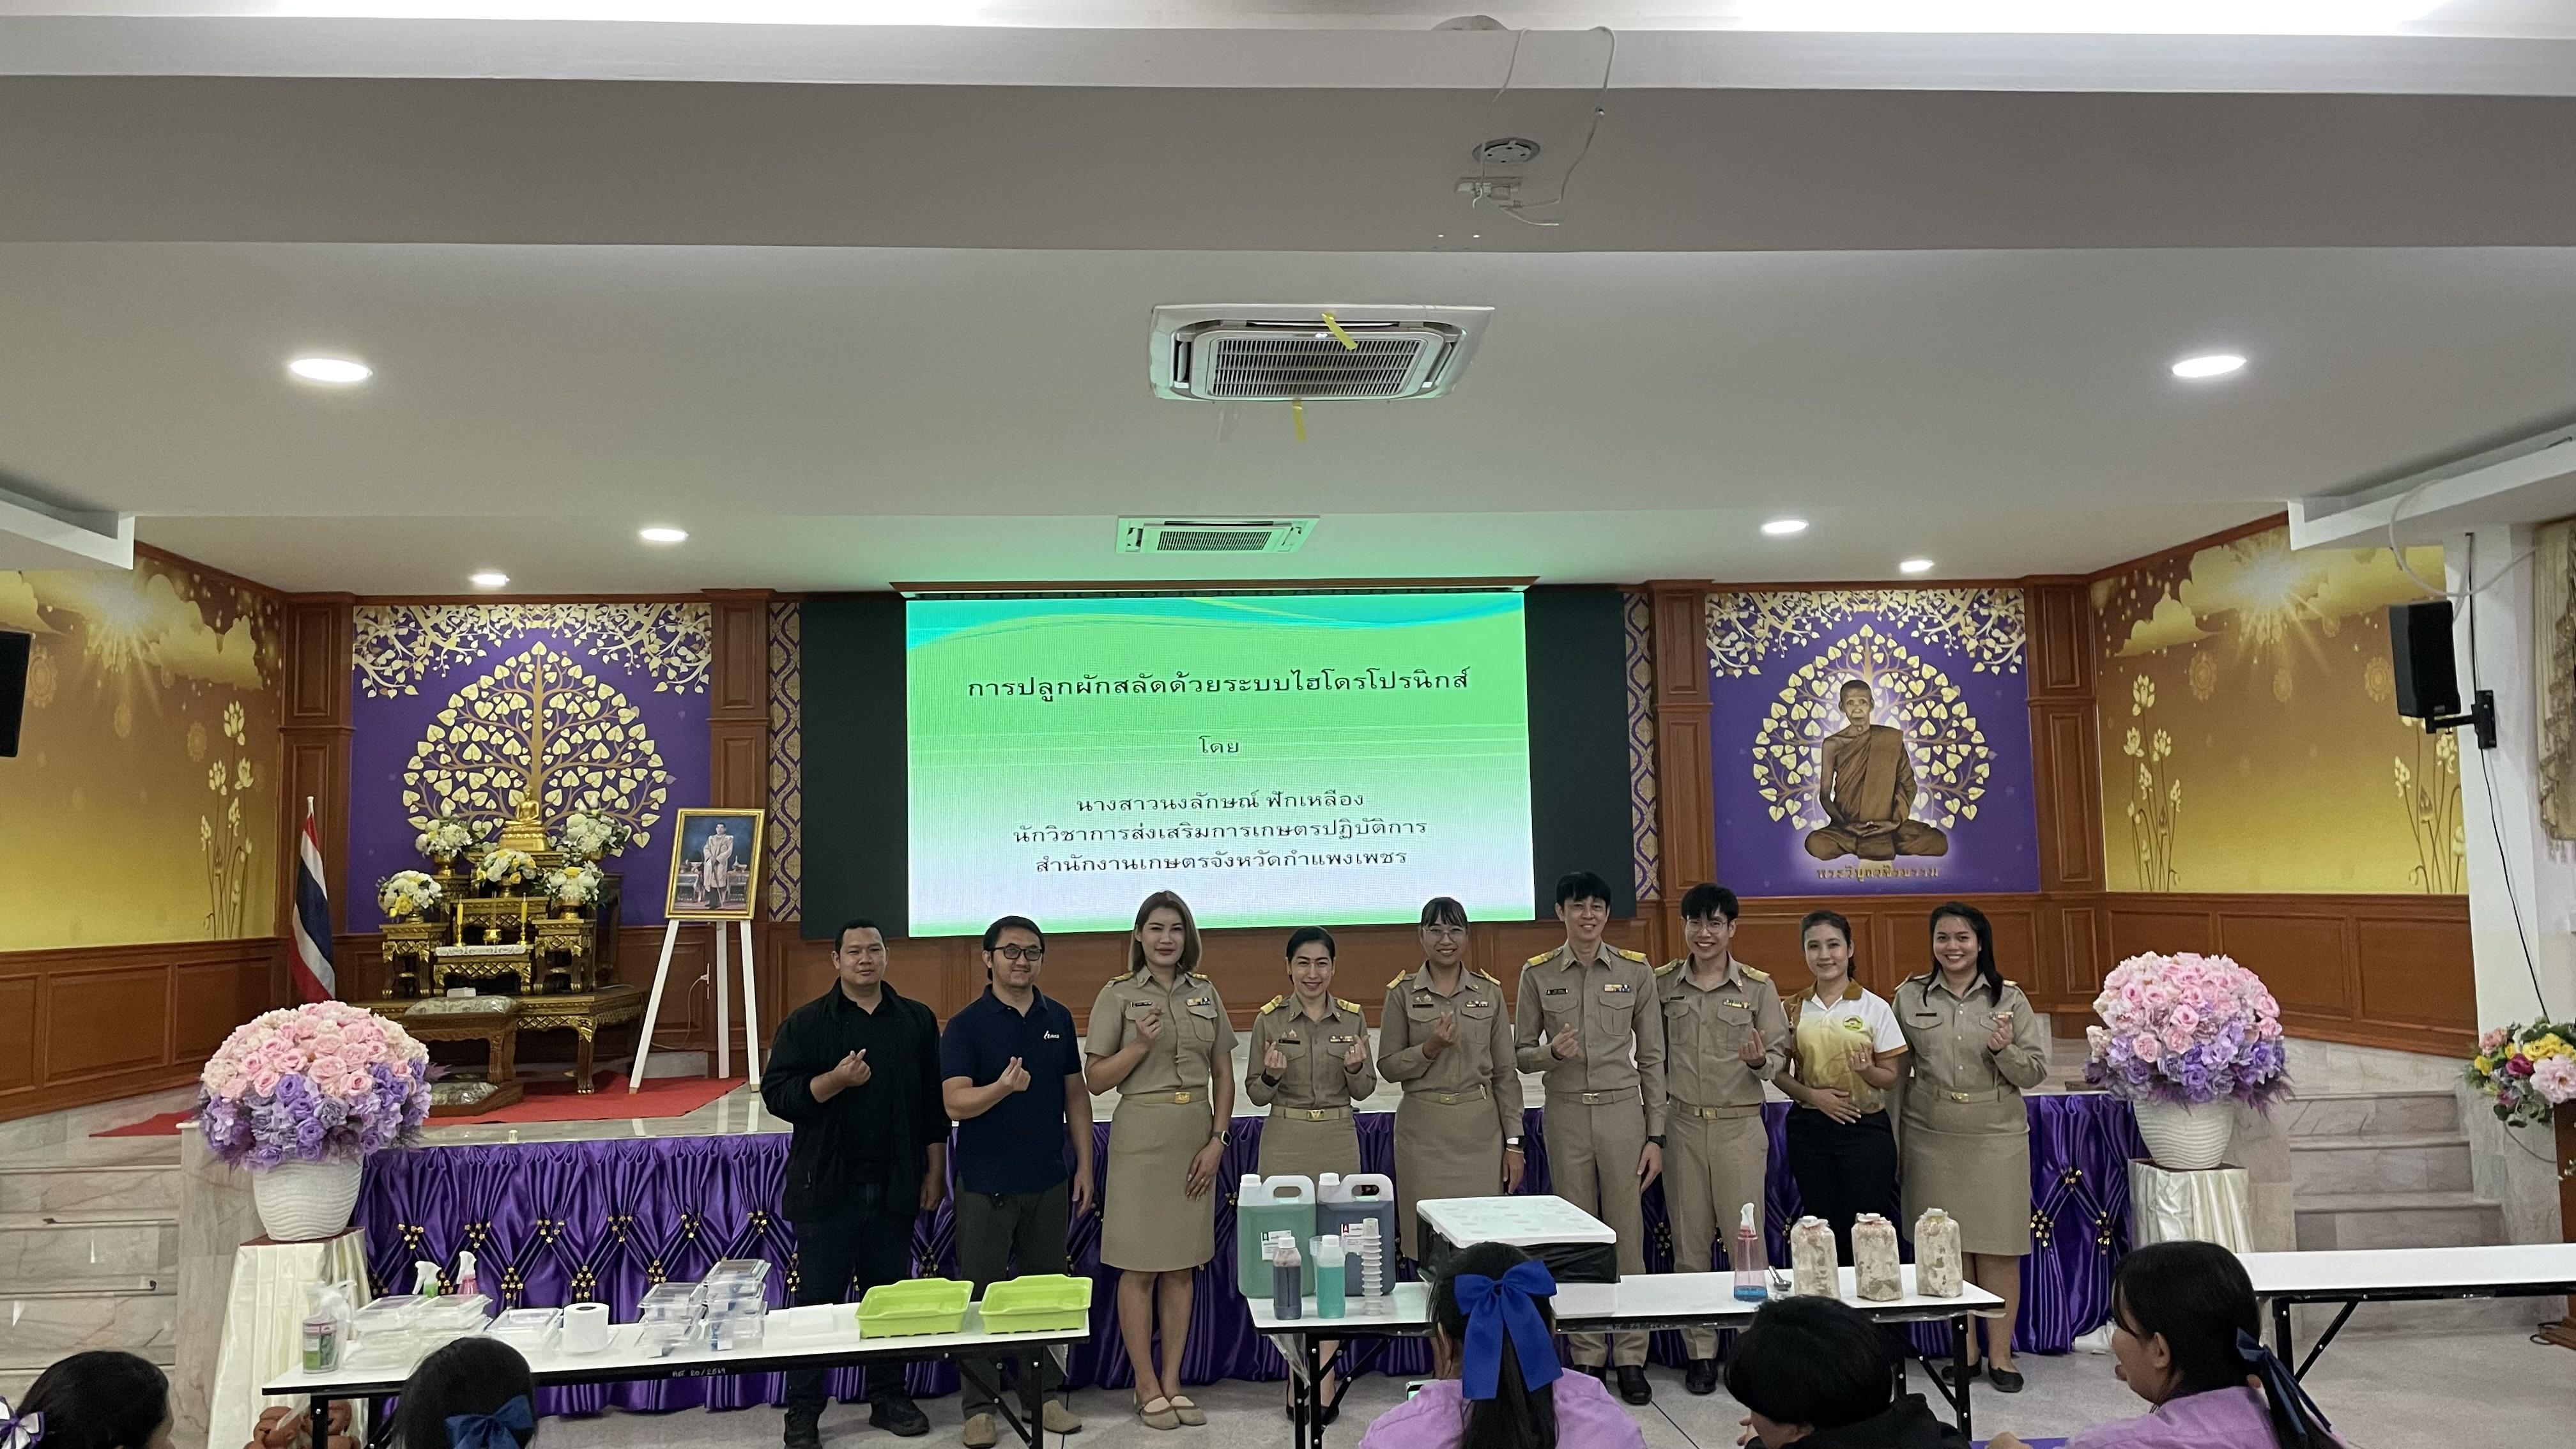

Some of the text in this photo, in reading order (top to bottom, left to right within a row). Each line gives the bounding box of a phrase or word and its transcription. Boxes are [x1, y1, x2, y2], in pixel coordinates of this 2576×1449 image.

[968, 666, 1470, 702] การปลูกผักสลัดด้วยระบบไฮโดรโปรนิกส์
[1199, 735, 1238, 753] โดย
[1076, 790, 1259, 811] นางสาวนงลักษณ์
[1013, 817, 1428, 842] นักวิชาการส่งเสริมการเกษตรปฏิบัติการ
[1036, 850, 1407, 872] สำนักงานเกษตรจังหวัดกำแพงเพชร
